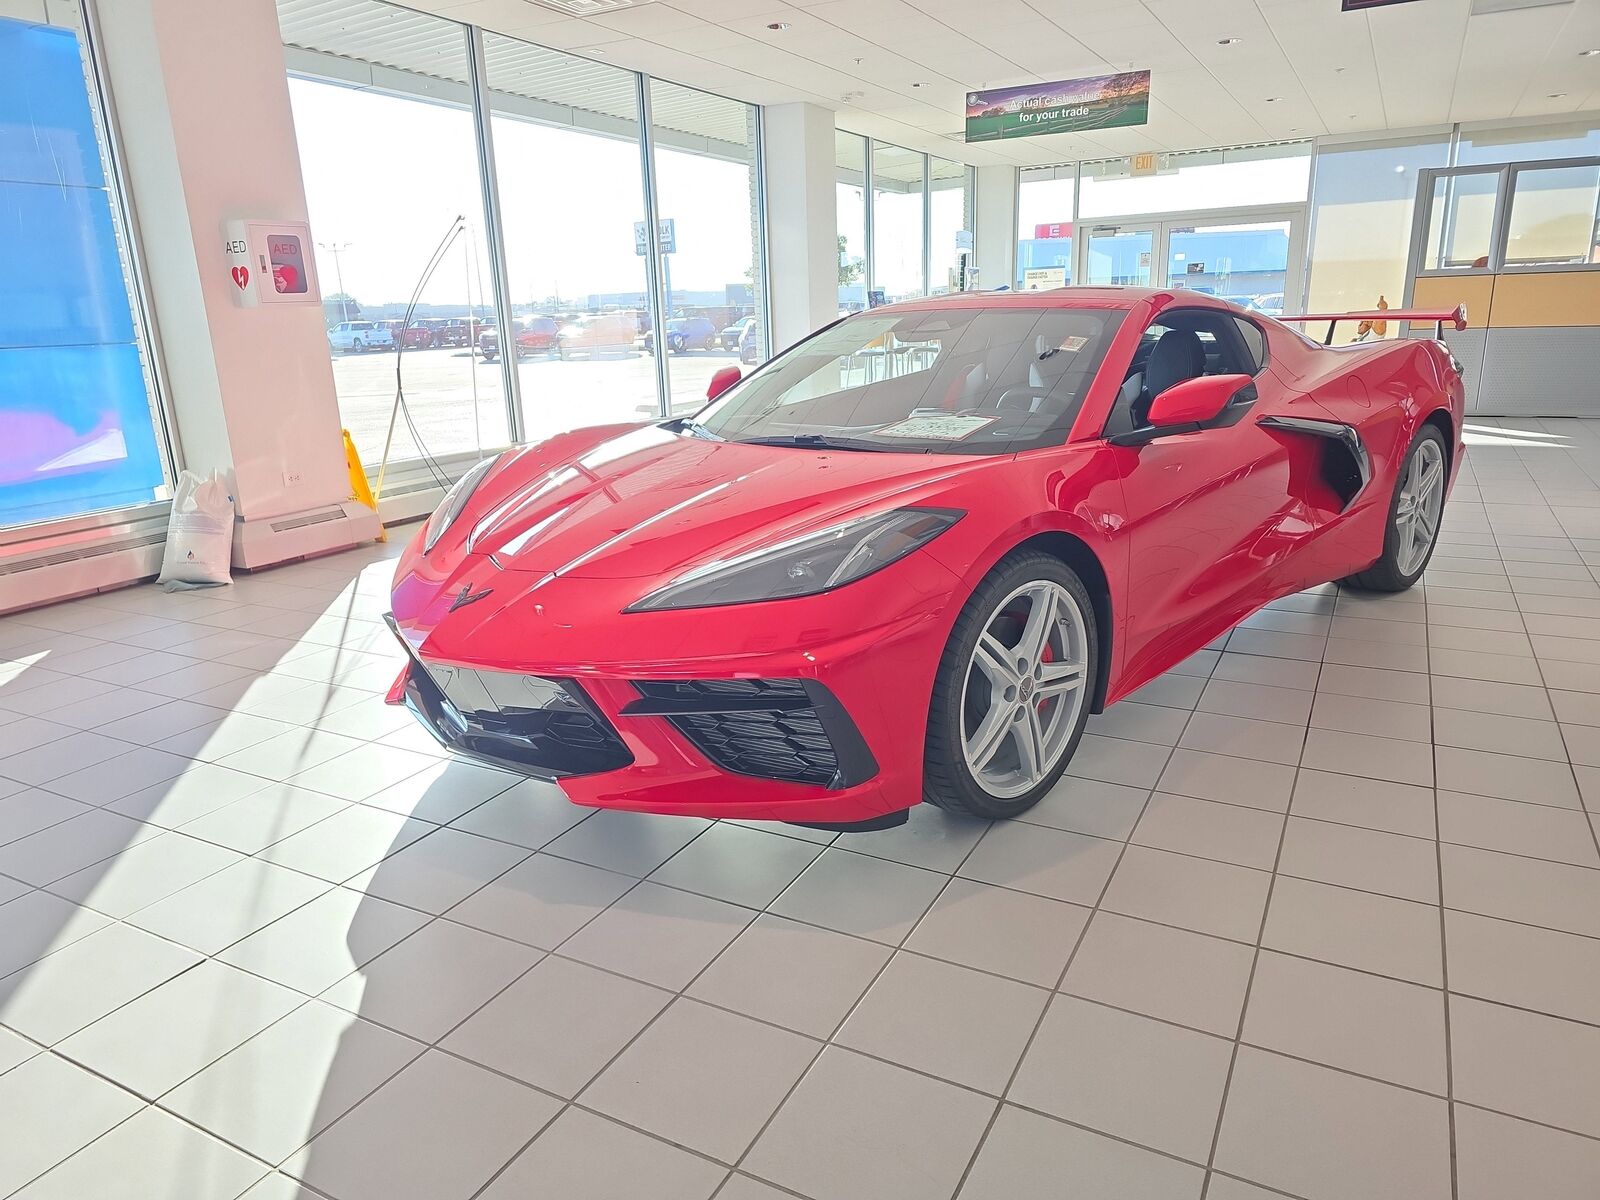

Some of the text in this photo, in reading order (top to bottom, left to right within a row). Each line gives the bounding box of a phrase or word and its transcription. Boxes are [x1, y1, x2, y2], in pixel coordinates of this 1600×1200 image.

[1010, 96, 1042, 110] Actual
[1045, 93, 1069, 106] cash
[1019, 105, 1090, 123] for your trade
[1136, 155, 1153, 170] EXIT
[225, 240, 247, 254] AED
[273, 243, 298, 255] AED
